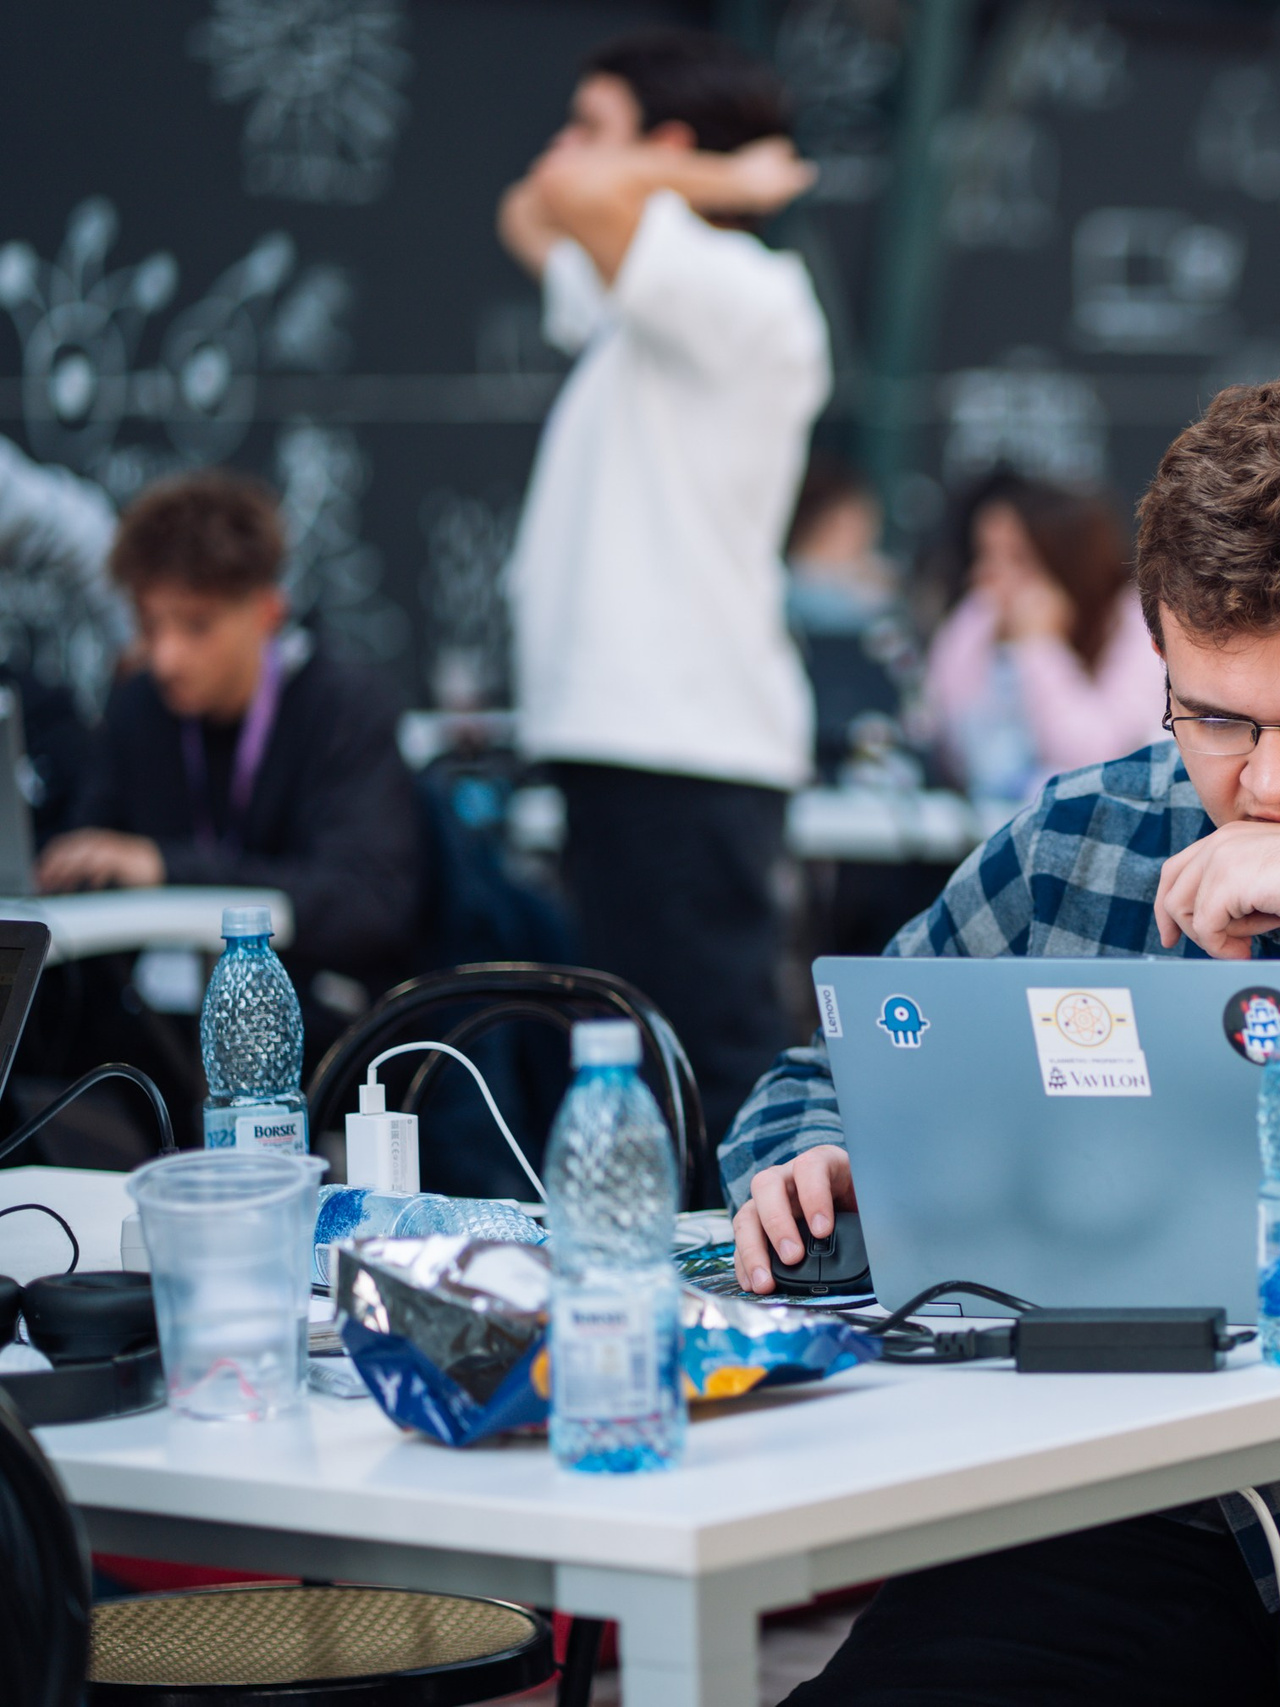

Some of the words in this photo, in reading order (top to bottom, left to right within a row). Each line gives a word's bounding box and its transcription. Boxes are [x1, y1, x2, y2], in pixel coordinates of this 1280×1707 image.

[822, 989, 838, 1034] Lenovo
[1070, 1071, 1146, 1087] VAVILON
[254, 1123, 297, 1138] BORSEC
